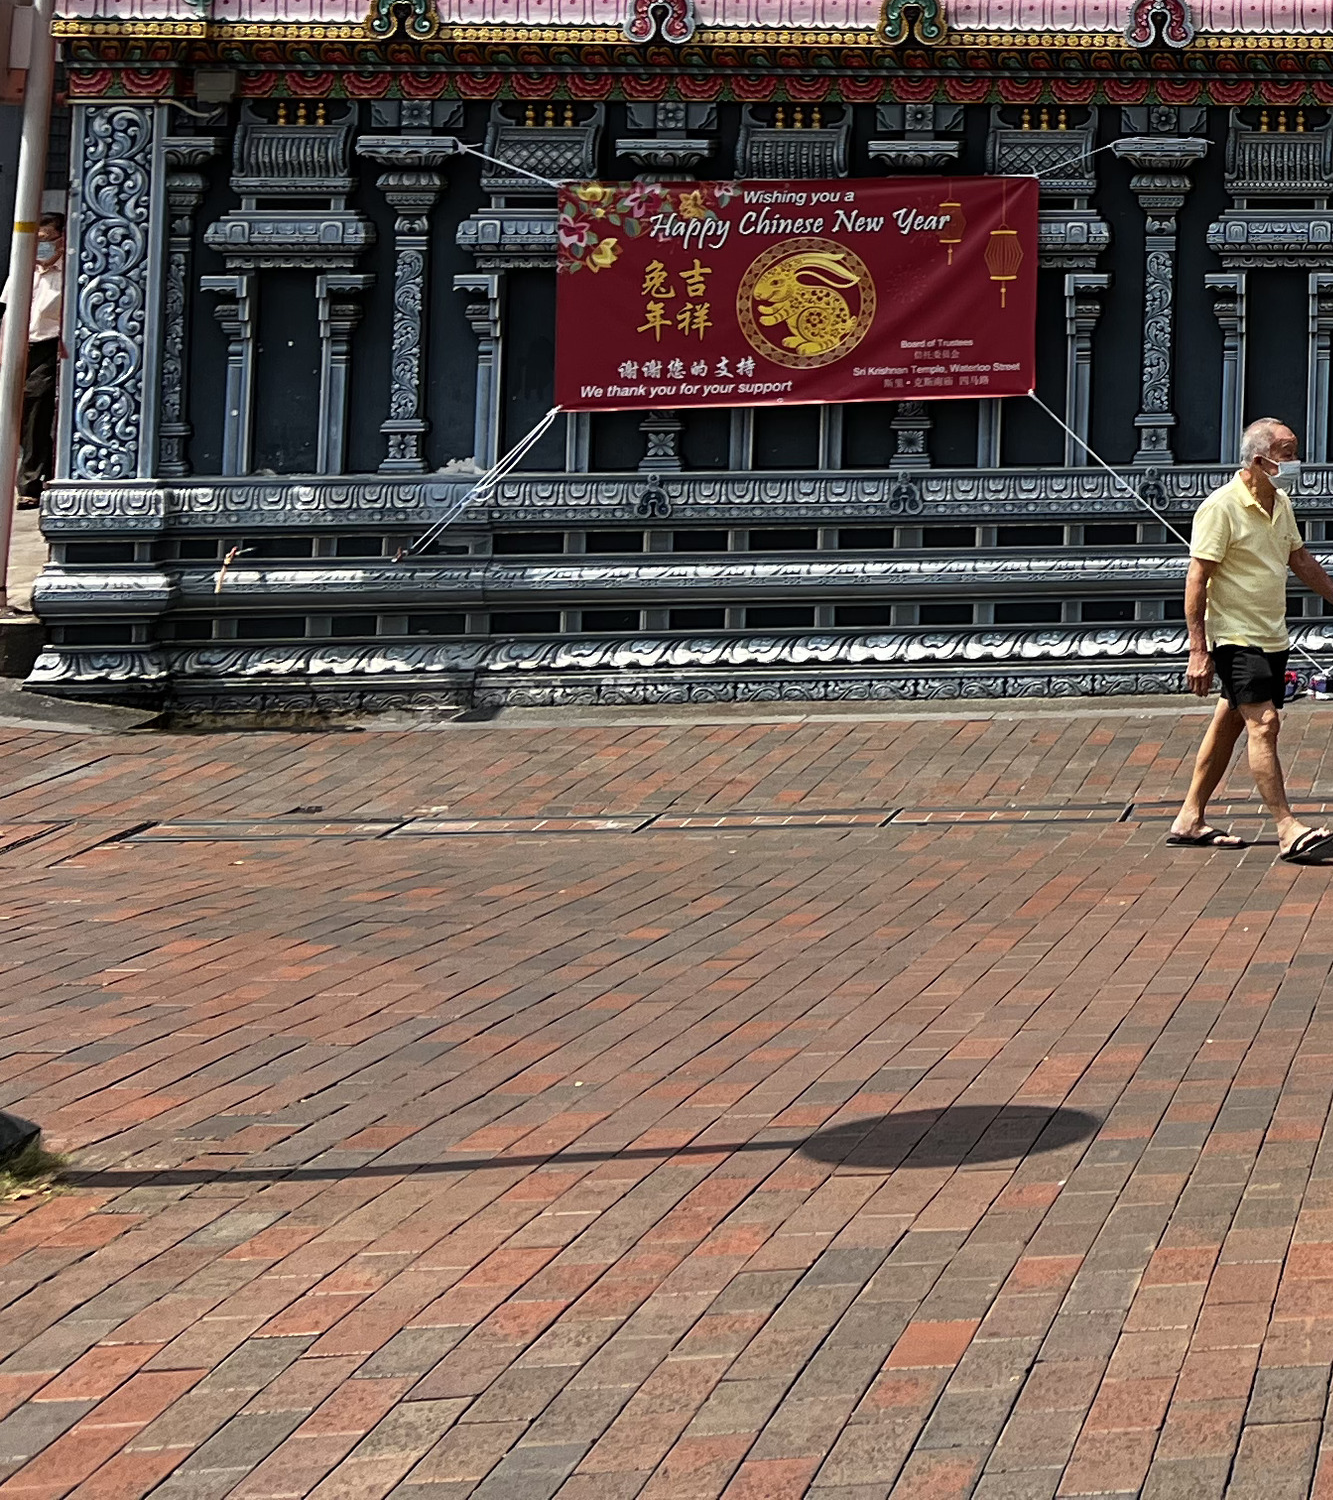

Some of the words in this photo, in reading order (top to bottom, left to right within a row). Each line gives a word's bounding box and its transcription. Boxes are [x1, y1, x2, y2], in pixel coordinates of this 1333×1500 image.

[743, 190, 807, 206] Wishing
[809, 192, 840, 206] you
[843, 191, 855, 203] a
[649, 212, 731, 250] Happy
[738, 206, 824, 235] Chinese
[831, 208, 885, 233] New
[891, 207, 951, 235] Year
[900, 340, 926, 349] Board
[926, 339, 936, 348] of
[936, 338, 974, 347] Trustees
[617, 356, 757, 380] 谢谢您的支持
[852, 367, 867, 376] Sri
[949, 363, 992, 373] Waterloo
[992, 361, 1021, 372] Street
[580, 386, 604, 398] We
[606, 384, 647, 397] thank
[648, 385, 678, 398] you
[678, 382, 701, 395] for
[701, 382, 735, 396] your
[737, 380, 794, 394] support
